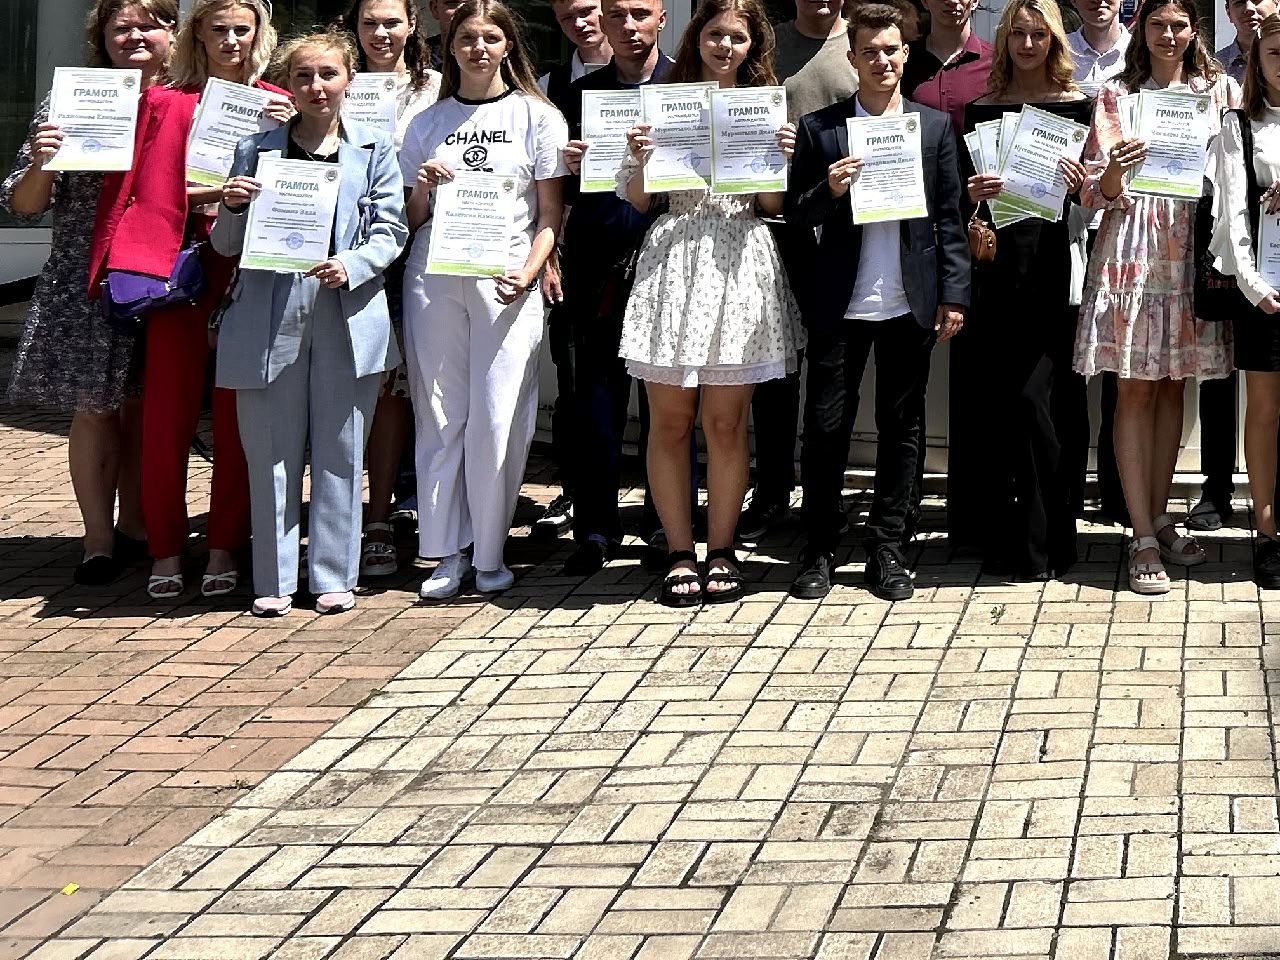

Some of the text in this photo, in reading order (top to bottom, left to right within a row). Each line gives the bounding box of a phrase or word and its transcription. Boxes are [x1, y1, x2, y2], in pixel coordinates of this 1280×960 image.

[73, 88, 119, 98] ГРАМОТА
[220, 101, 264, 120] ГРАМОТА
[661, 101, 704, 113] ГРАМОТА
[728, 106, 770, 117] ГРАМОТА
[600, 109, 640, 118] ГРАМОТА
[1155, 108, 1194, 121] ГРАМОТА
[444, 129, 513, 146] CHANEL
[866, 134, 906, 146] ГРАМОТА
[1031, 127, 1069, 148] ГРАМОТА
[275, 179, 320, 192] ГРАМОТА
[456, 189, 500, 201] ГРАМОТА
